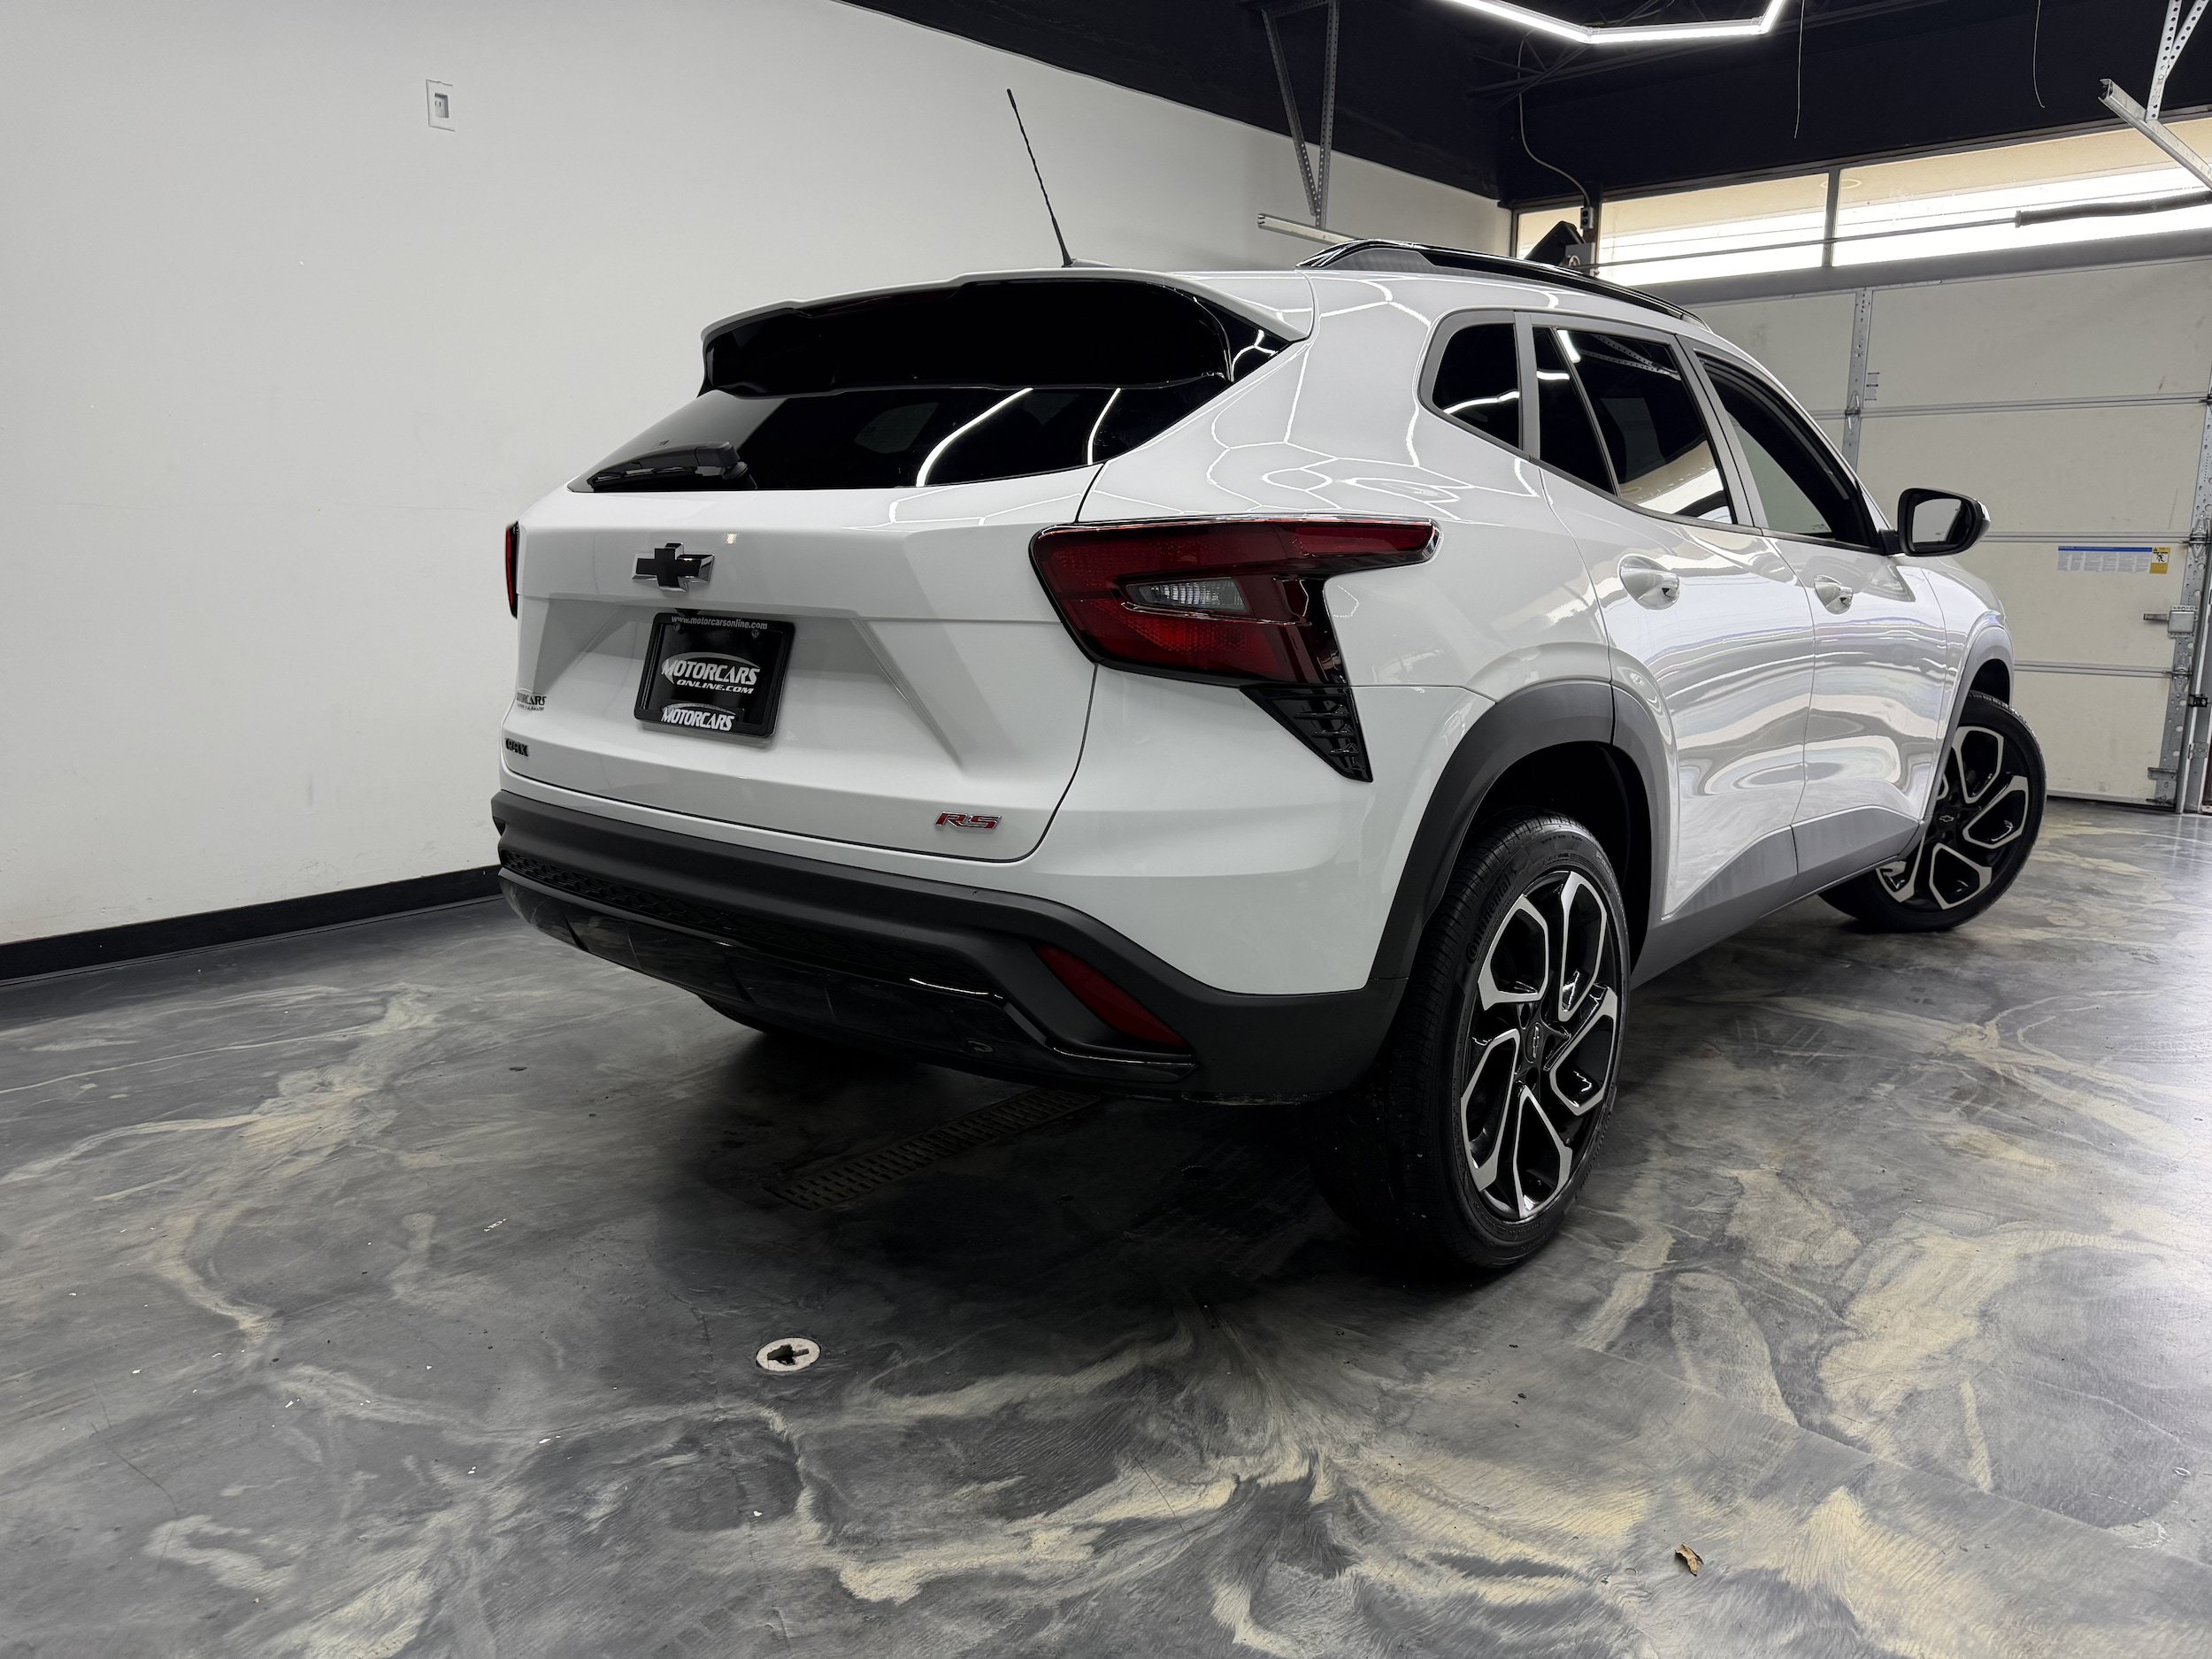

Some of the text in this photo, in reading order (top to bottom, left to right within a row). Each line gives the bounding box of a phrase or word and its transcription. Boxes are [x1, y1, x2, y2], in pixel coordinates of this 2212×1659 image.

[671, 615, 768, 630] www.motorcarsonline.com
[662, 658, 760, 686] MOTORCARS
[676, 680, 755, 695] ONLINE.COM
[661, 707, 735, 732] MOTORCARS
[935, 811, 1002, 830] RS
